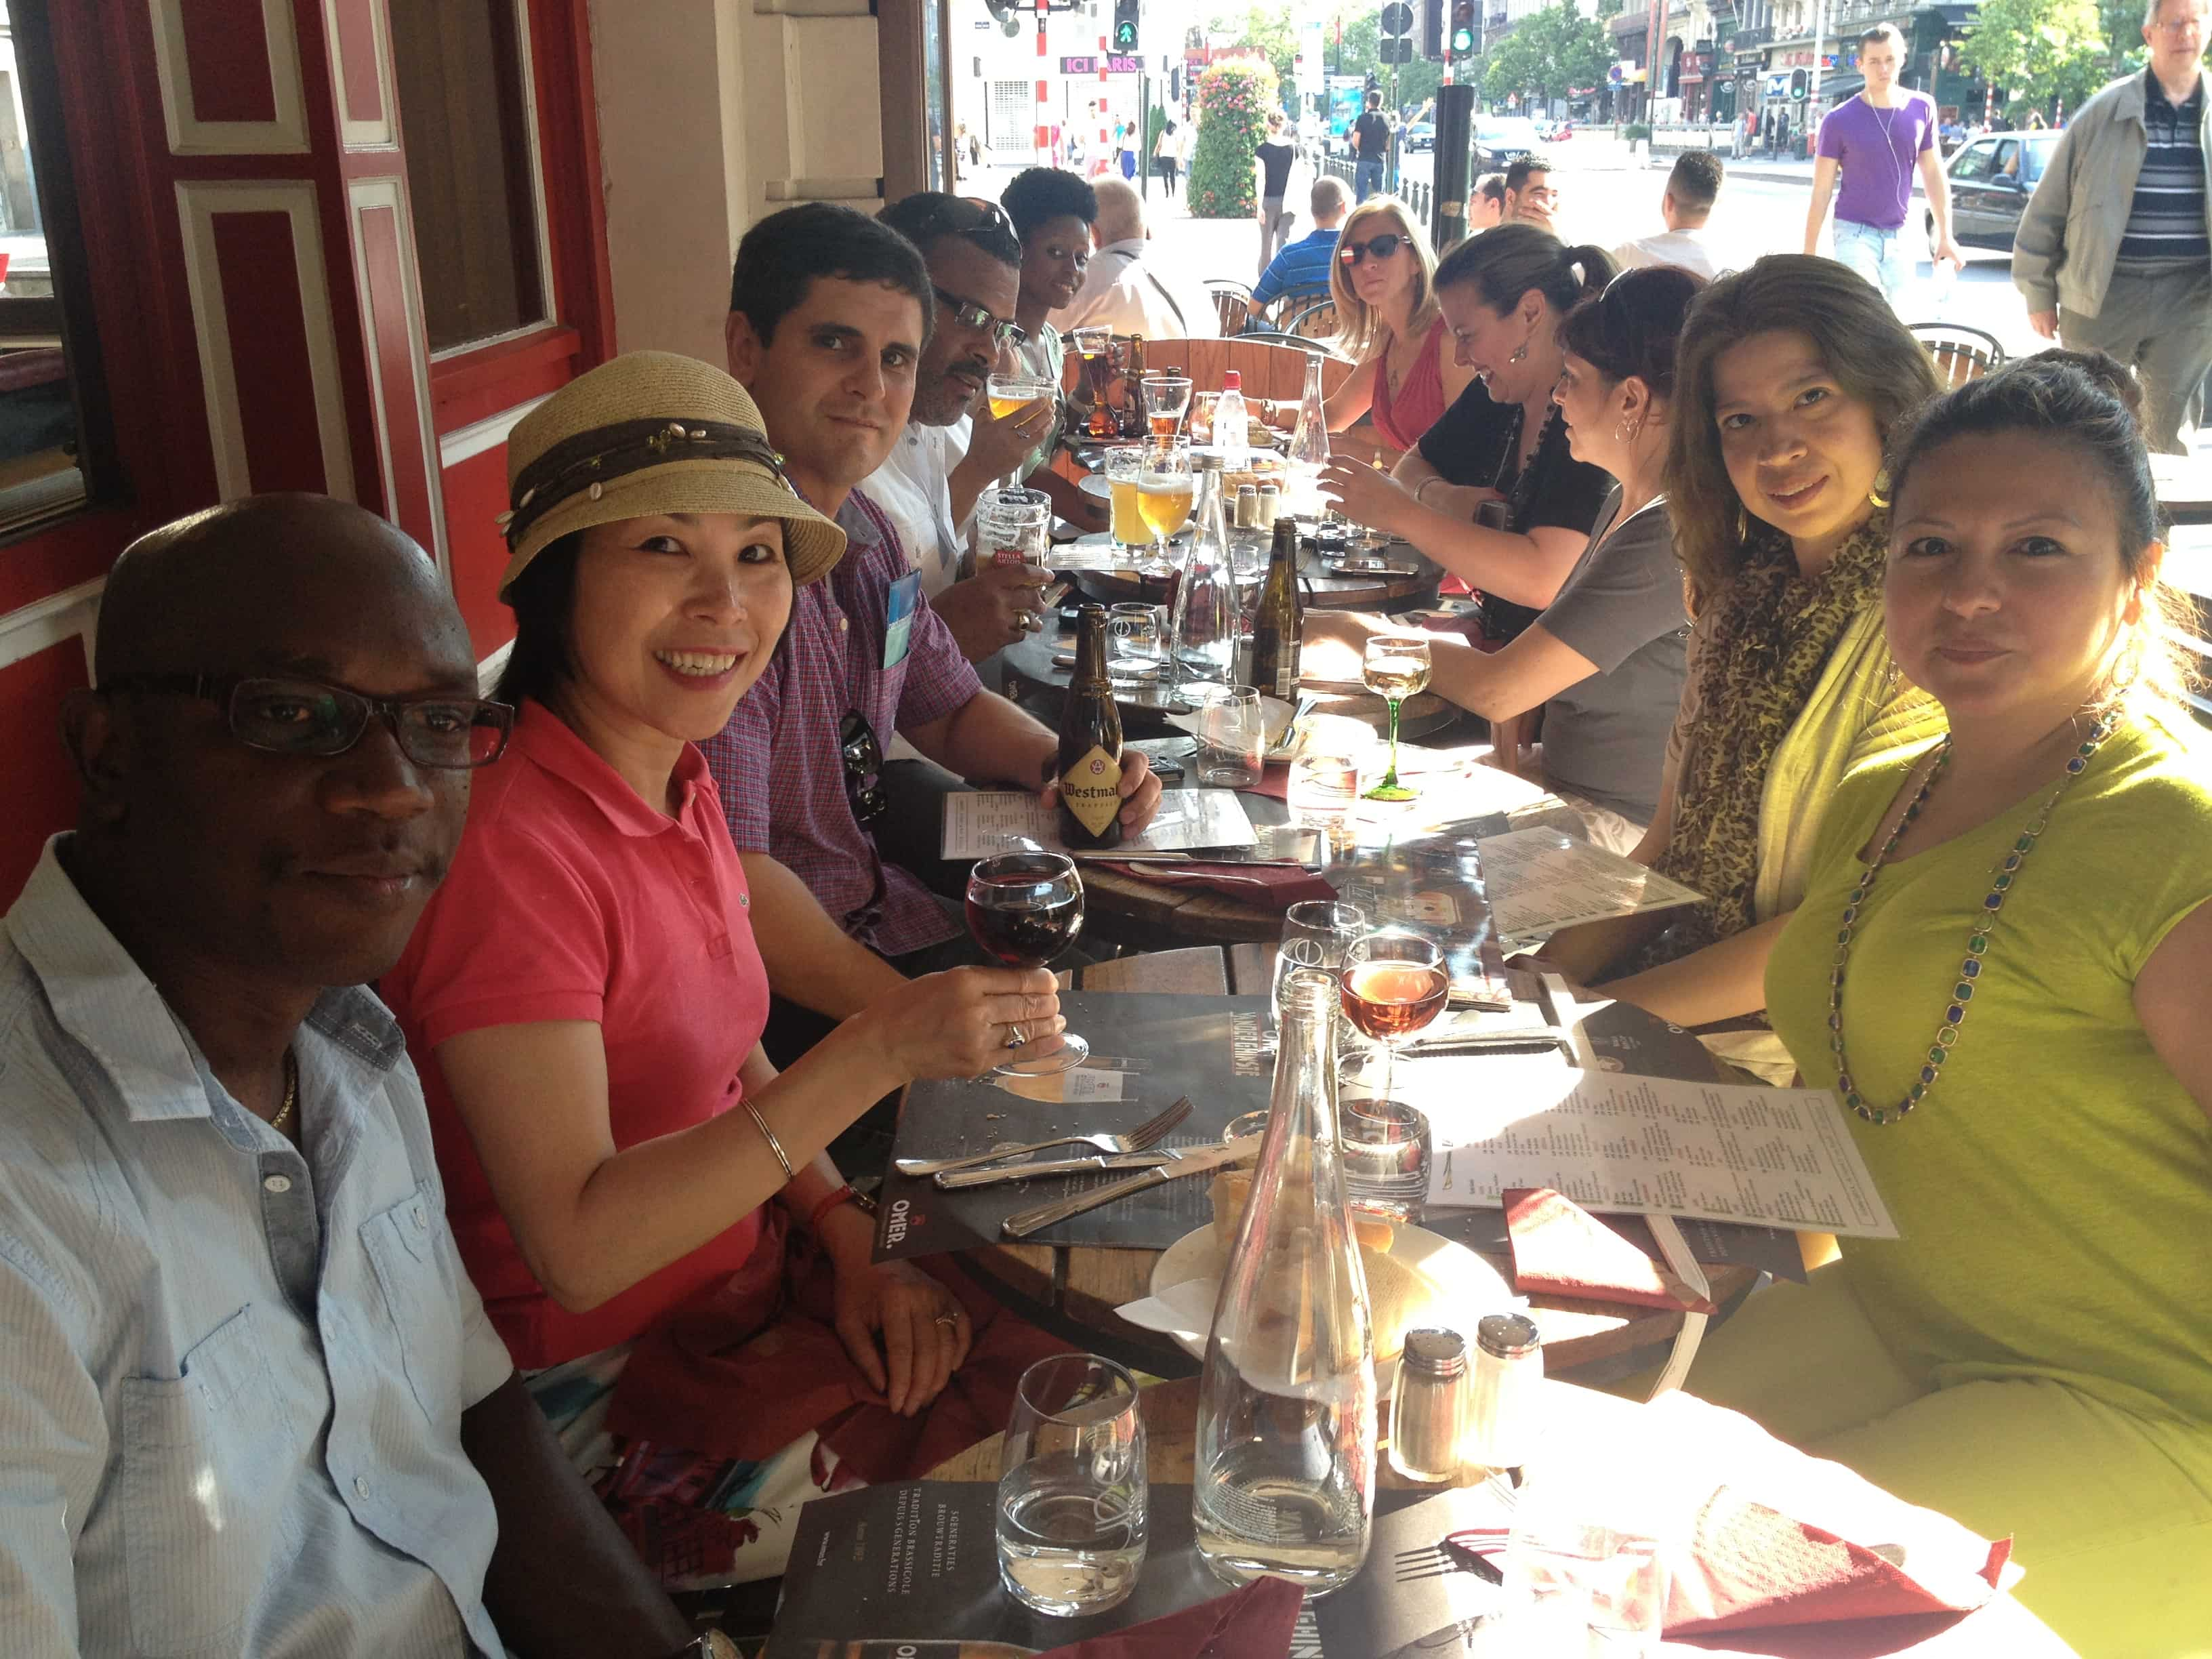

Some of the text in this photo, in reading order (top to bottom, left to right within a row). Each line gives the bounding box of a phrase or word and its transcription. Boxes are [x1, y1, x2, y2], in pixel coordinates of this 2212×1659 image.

[1067, 58, 1088, 73] ICI
[1766, 77, 1790, 96] M
[895, 1489, 908, 1520] DEPUIS
[887, 1528, 903, 1594] GENERATIONS
[931, 1503, 947, 1578] BROUWTRADITIE
[946, 1516, 959, 1572] GENERATIES
[901, 1538, 916, 1595] BRASSICOLE
[896, 1645, 918, 1659] O
